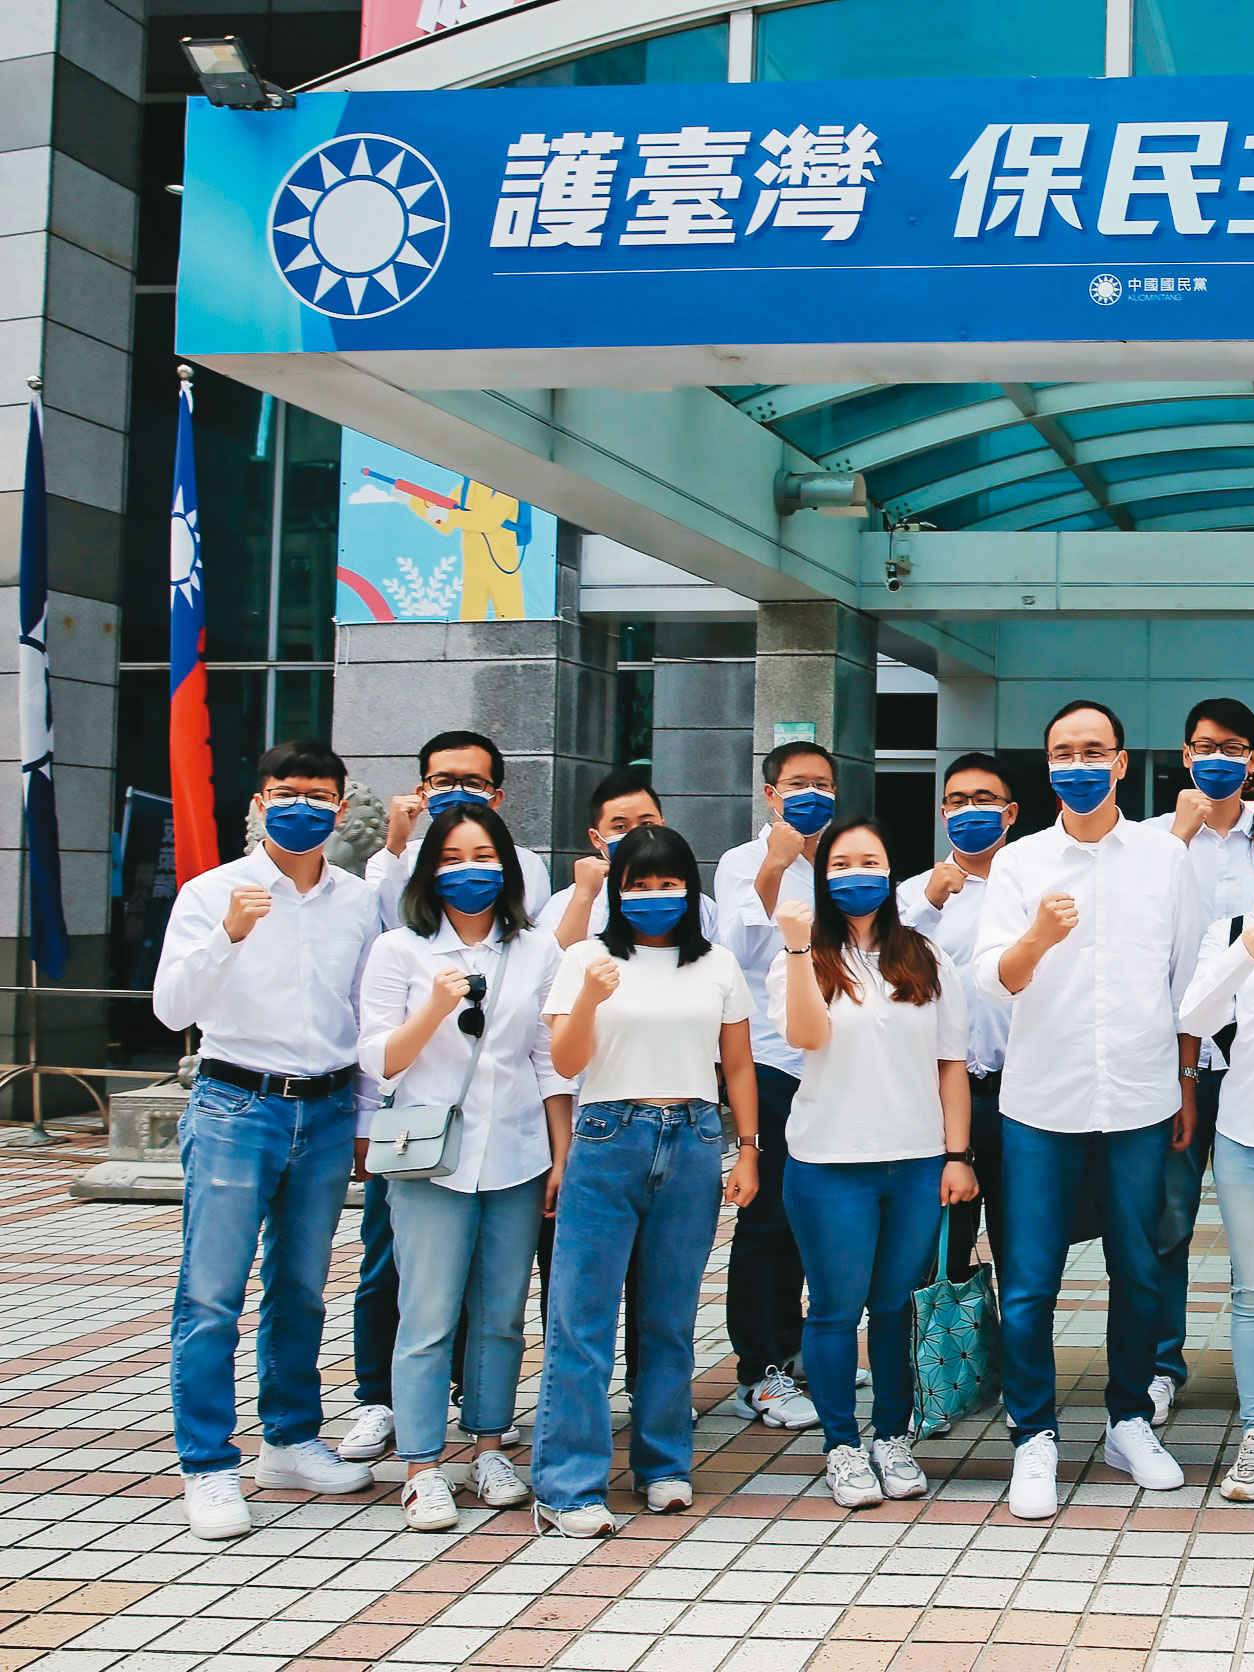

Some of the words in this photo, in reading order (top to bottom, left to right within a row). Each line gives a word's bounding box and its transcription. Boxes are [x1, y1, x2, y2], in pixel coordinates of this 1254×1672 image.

[489, 123, 883, 248] 護臺灣
[1128, 277, 1208, 292] 中國國民黨
[1128, 294, 1182, 302] KUOMINTANG
